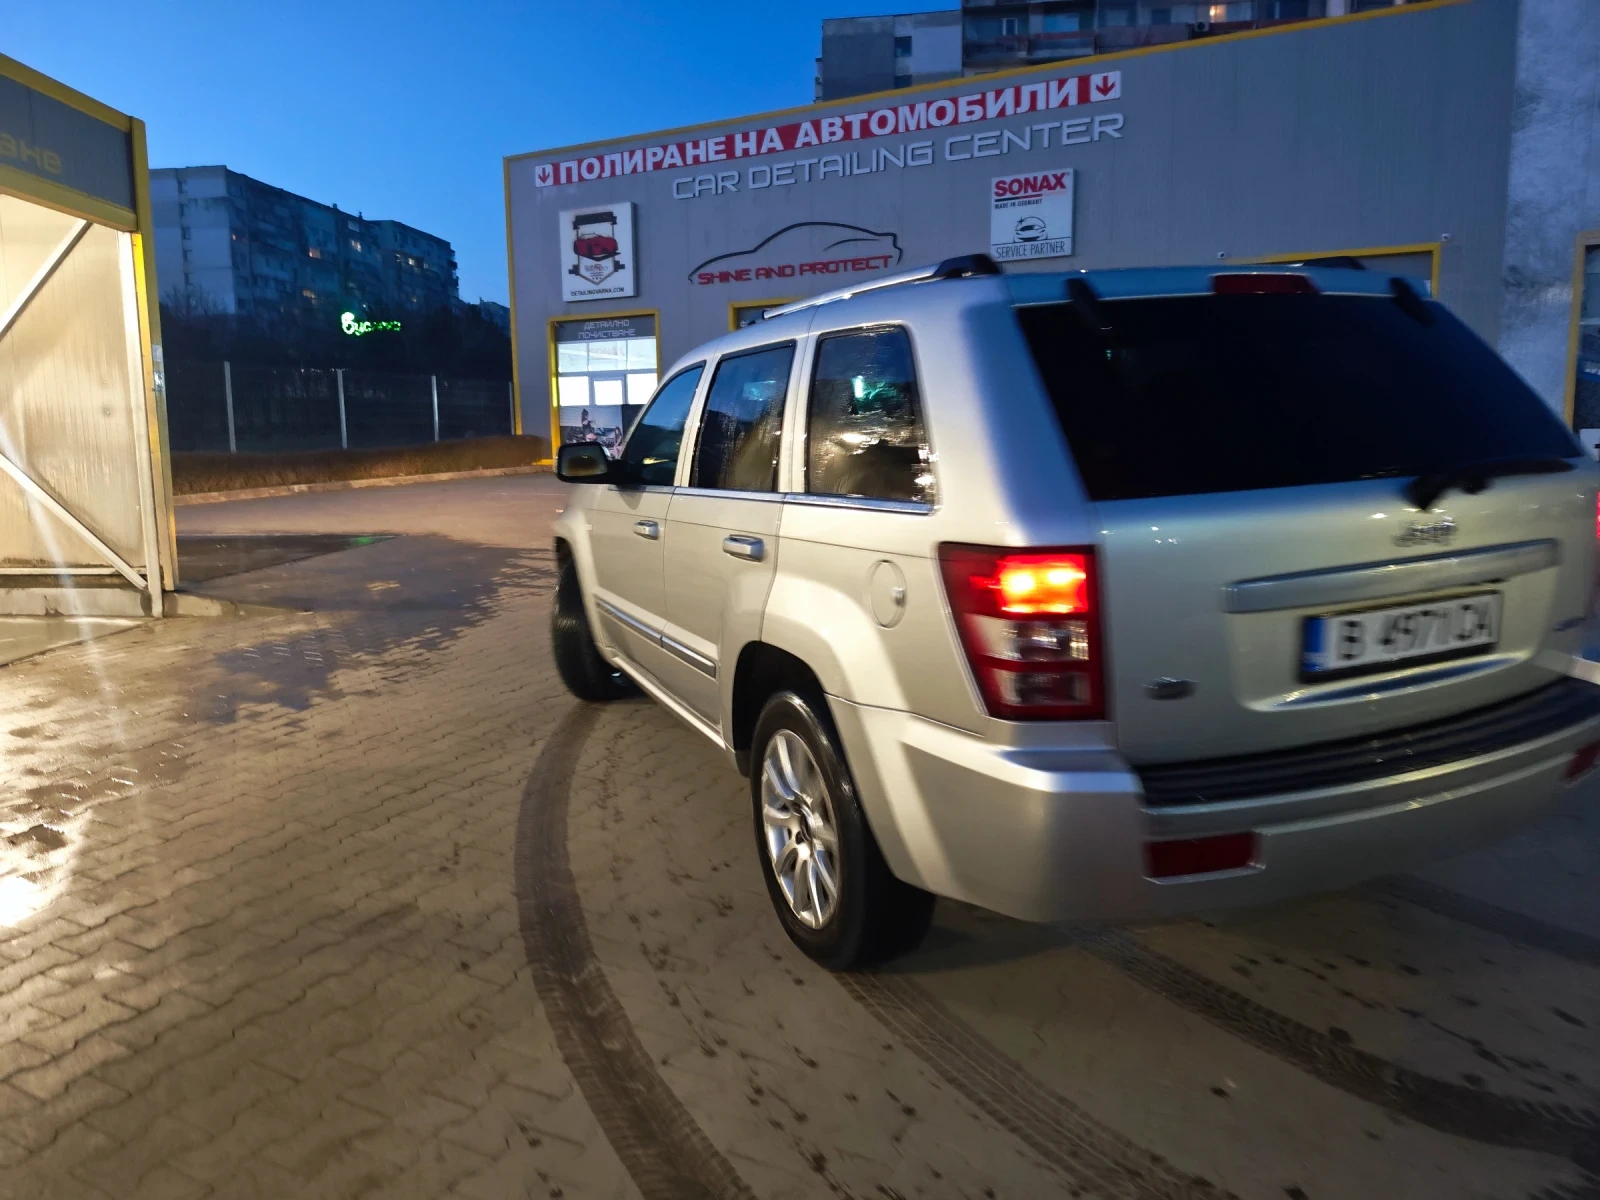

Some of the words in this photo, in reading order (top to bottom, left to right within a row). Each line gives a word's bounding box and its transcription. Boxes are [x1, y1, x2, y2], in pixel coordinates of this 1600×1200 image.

[560, 138, 727, 184] ПОЛИРАНЕ
[735, 129, 784, 156] НА
[796, 76, 1079, 147] АВТОМОБИЛИ
[672, 168, 741, 201] CAR
[748, 140, 933, 190] DETAILING
[944, 112, 1125, 162] CENTER
[994, 172, 1067, 198] SONAX
[994, 202, 1009, 210] MADE
[1017, 199, 1043, 207] GERMANY
[996, 244, 1028, 259] SERVICE
[1030, 240, 1066, 256] PARTNER
[698, 268, 753, 285] SHINE
[755, 264, 795, 280] AND
[799, 255, 893, 276] PROTECT
[571, 287, 625, 297] DETAILINGVARNA.COM
[578, 329, 636, 339] ПОЧИСТВАНЕ
[584, 319, 630, 331] ДЕТАЙЛНО
[1337, 618, 1366, 661] B
